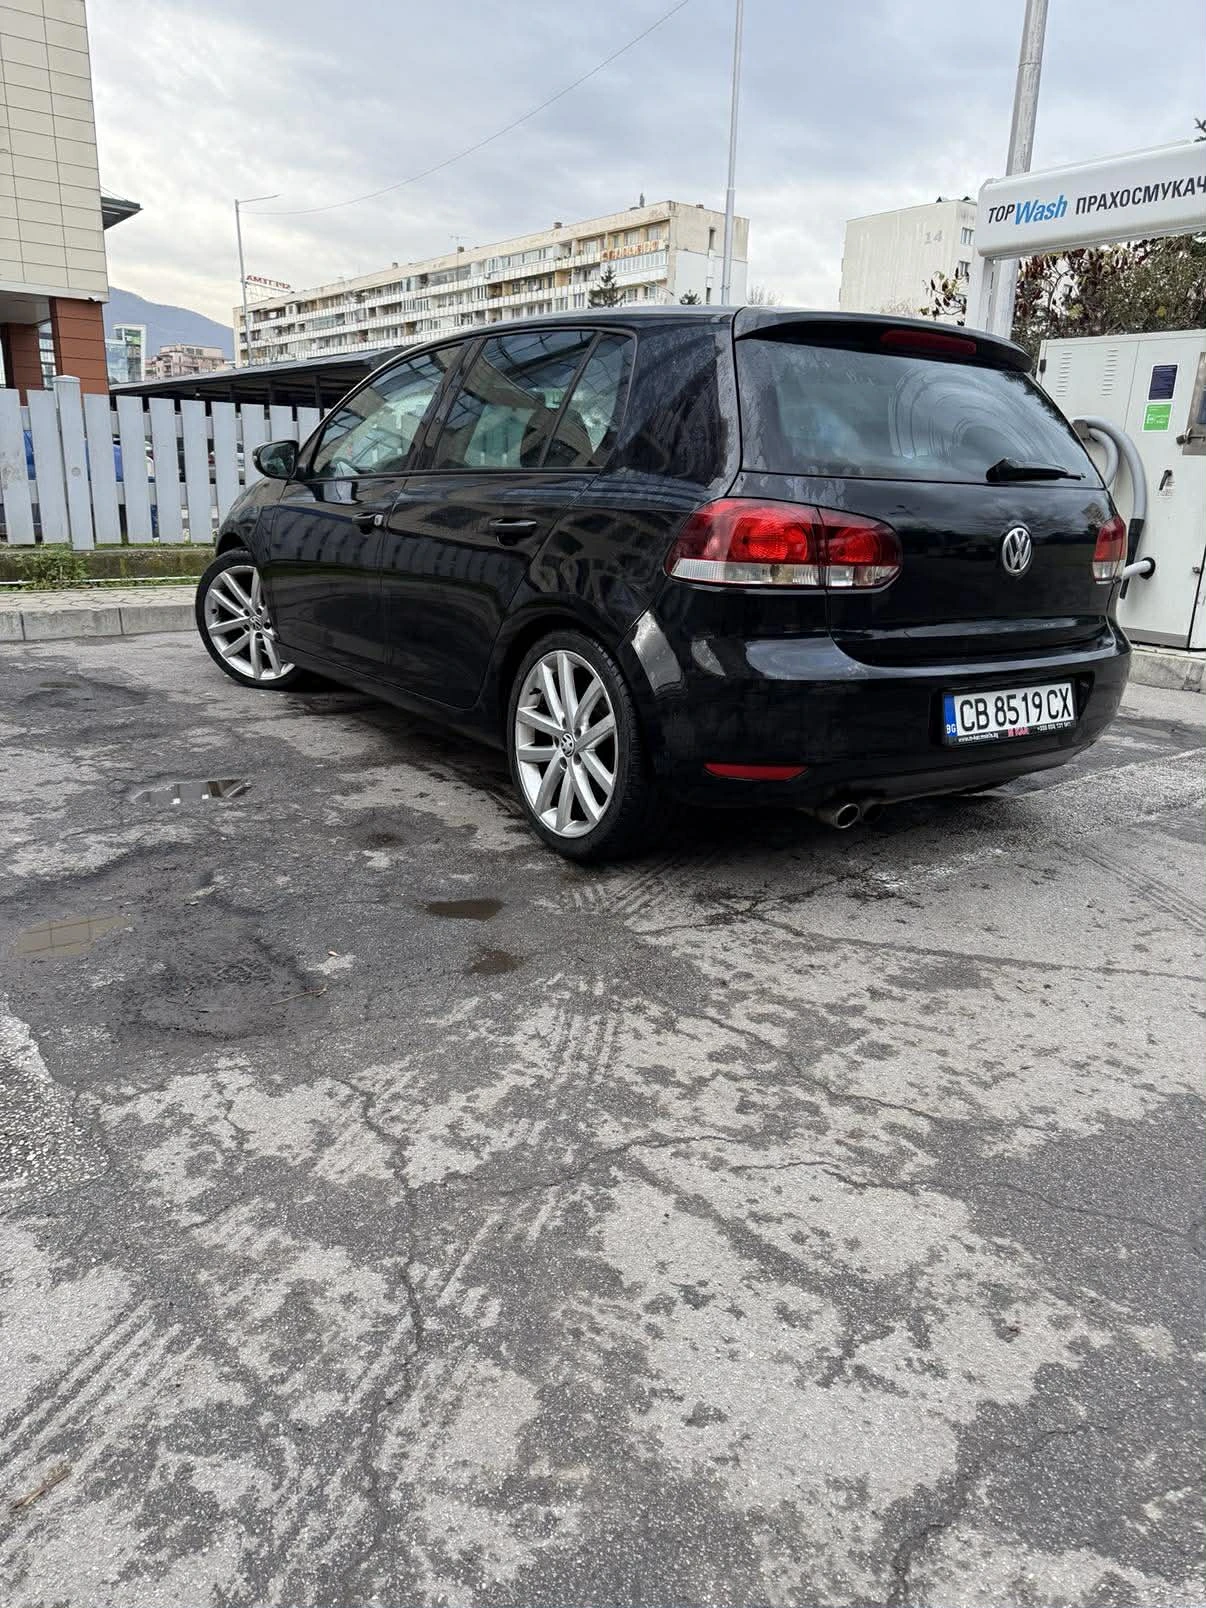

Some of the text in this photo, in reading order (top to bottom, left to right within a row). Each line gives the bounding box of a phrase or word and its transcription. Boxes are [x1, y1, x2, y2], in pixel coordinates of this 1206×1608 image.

[1075, 175, 1206, 215] ПРАХОСМУКАЧ
[946, 724, 957, 734] BG
[960, 687, 1072, 732] CB 8519 CX
